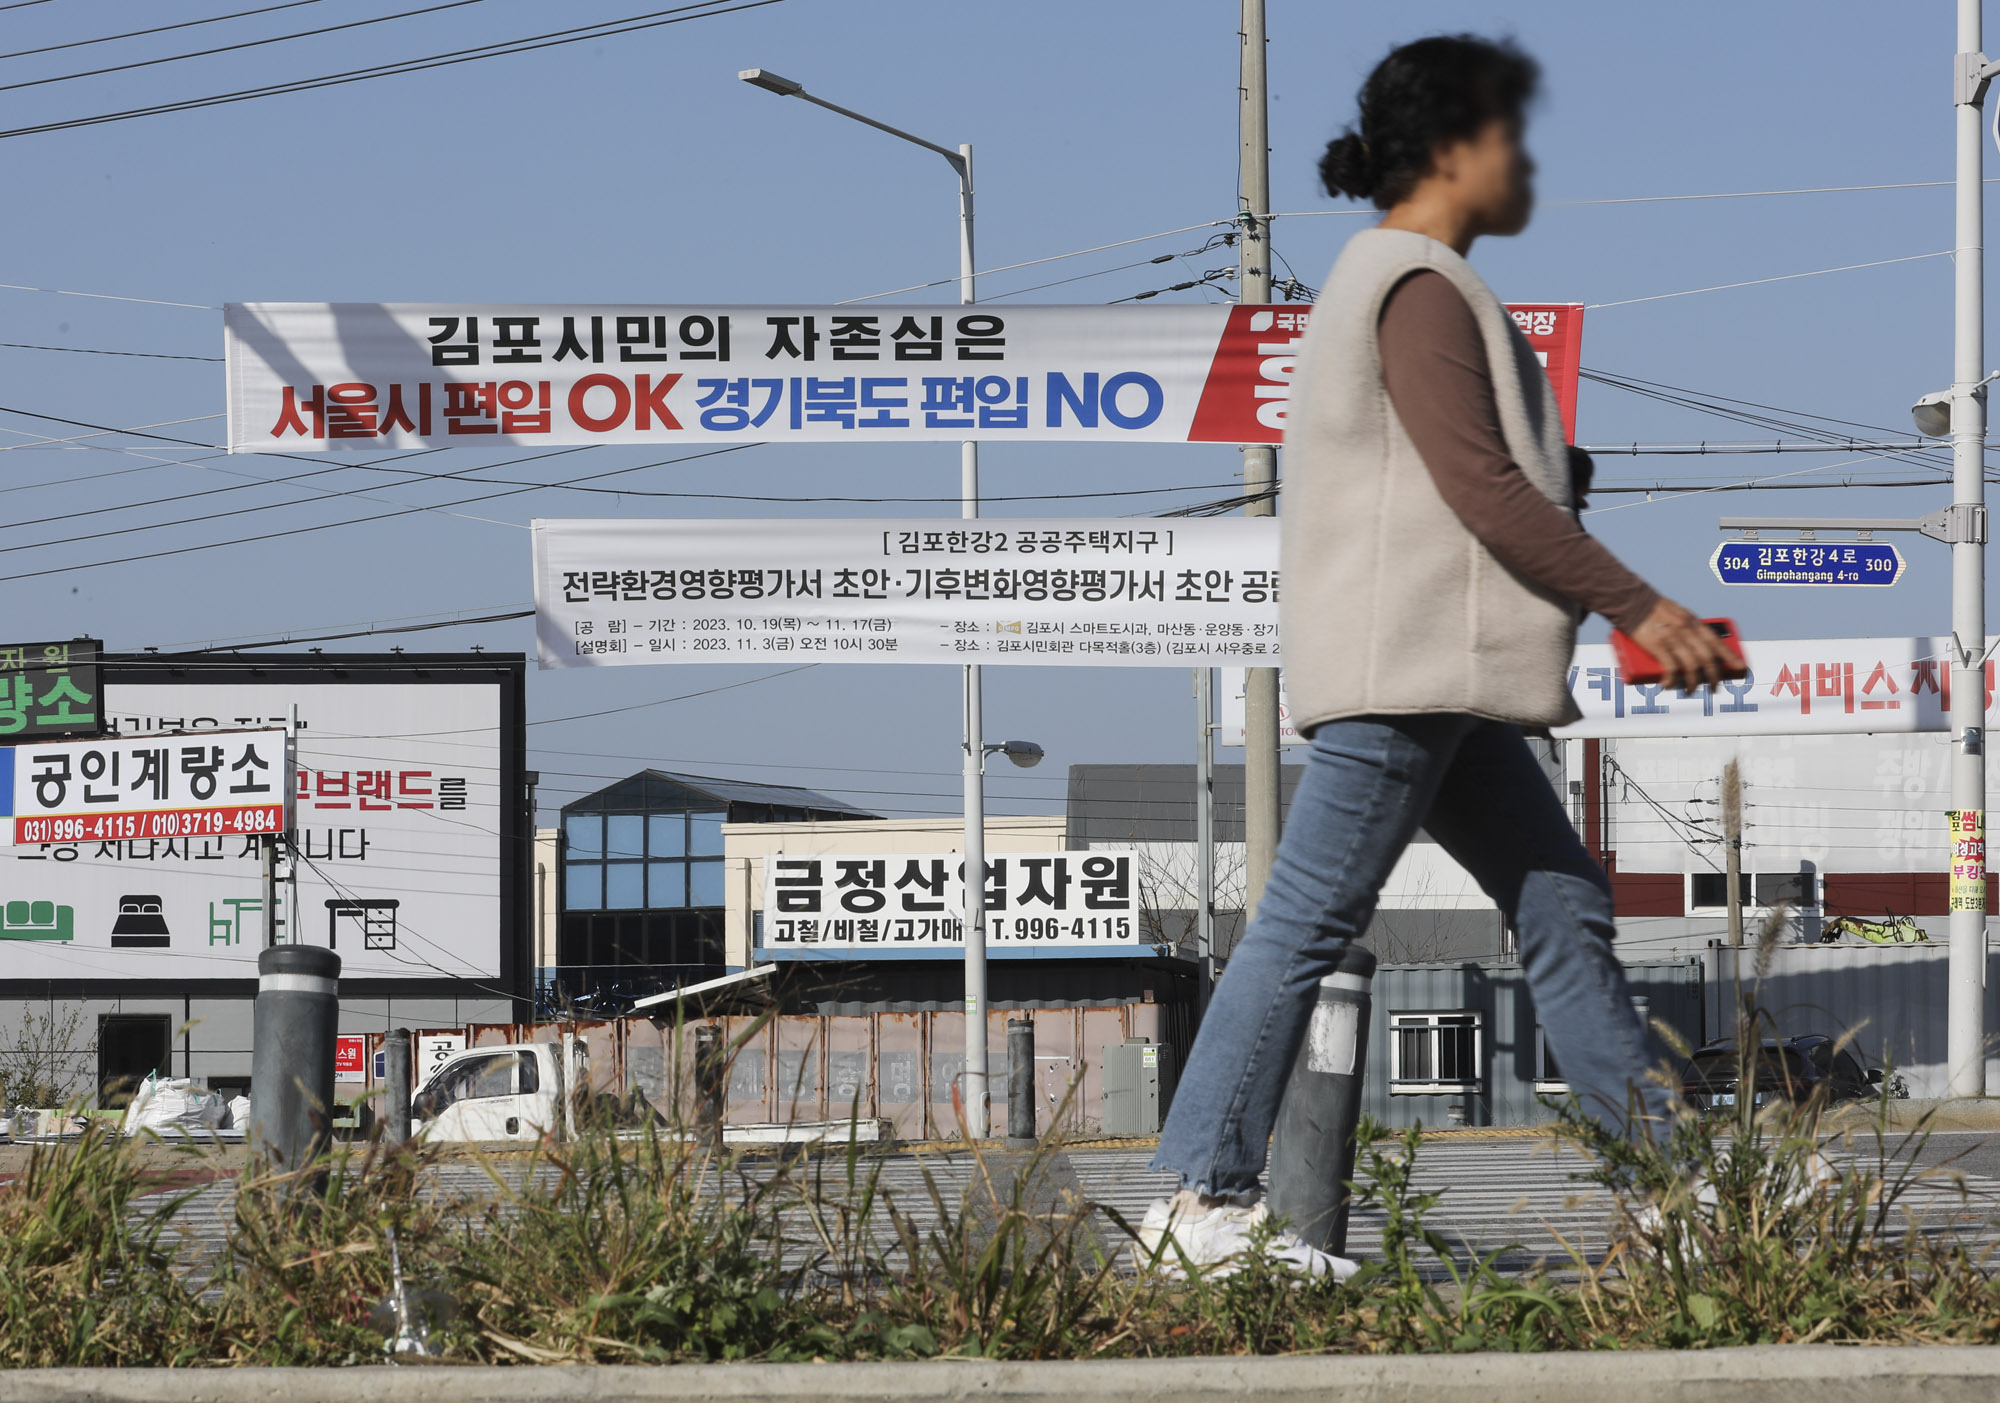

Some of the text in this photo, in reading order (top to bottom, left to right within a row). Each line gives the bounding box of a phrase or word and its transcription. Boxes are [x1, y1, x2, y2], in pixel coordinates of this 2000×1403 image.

[1507, 310, 1557, 336] 원장
[426, 314, 1006, 366] 김포시민의 자존심은
[269, 371, 1164, 439] 서울시 편입 OK 경기북도 편입 NO
[898, 530, 1009, 554] 김포한강2
[1015, 529, 1159, 554] 공공주택지구
[1723, 557, 1750, 570] 304
[1756, 569, 1859, 583] Gimpohangang 4-ro
[1865, 558, 1892, 572] 300
[562, 568, 822, 603] 전략환경영향평가서
[1174, 568, 1234, 603] 초안
[649, 618, 676, 633] 기간
[692, 618, 730, 631] 2023.
[736, 618, 757, 631] 10.
[762, 616, 802, 632] 19(목)
[826, 618, 846, 631] 11.
[852, 617, 892, 633] 17(금)
[953, 620, 980, 634] 장소
[1026, 621, 1064, 635] 김포시
[575, 638, 627, 654] [설명회]
[648, 637, 675, 652] 일시
[693, 637, 731, 651] 2023.
[737, 638, 757, 651] 11.
[762, 636, 795, 651] 3(금)
[799, 637, 827, 651] 오전
[833, 637, 862, 651] 10시
[868, 637, 899, 651] 30분
[954, 639, 981, 652] 장소
[997, 639, 1075, 654] 김포시민회관
[1166, 641, 1210, 656] (김포시
[1214, 642, 1268, 656] 사우중로
[1770, 660, 1901, 715] 서비스
[31, 743, 271, 809] 공인계량소
[23, 818, 136, 842] 031)996-4115
[151, 808, 277, 836] 010)3719-4984
[775, 857, 1130, 913] 금정산업자원
[774, 918, 963, 943] 고철/비철/고가매
[1014, 916, 1130, 940] 996-4115
